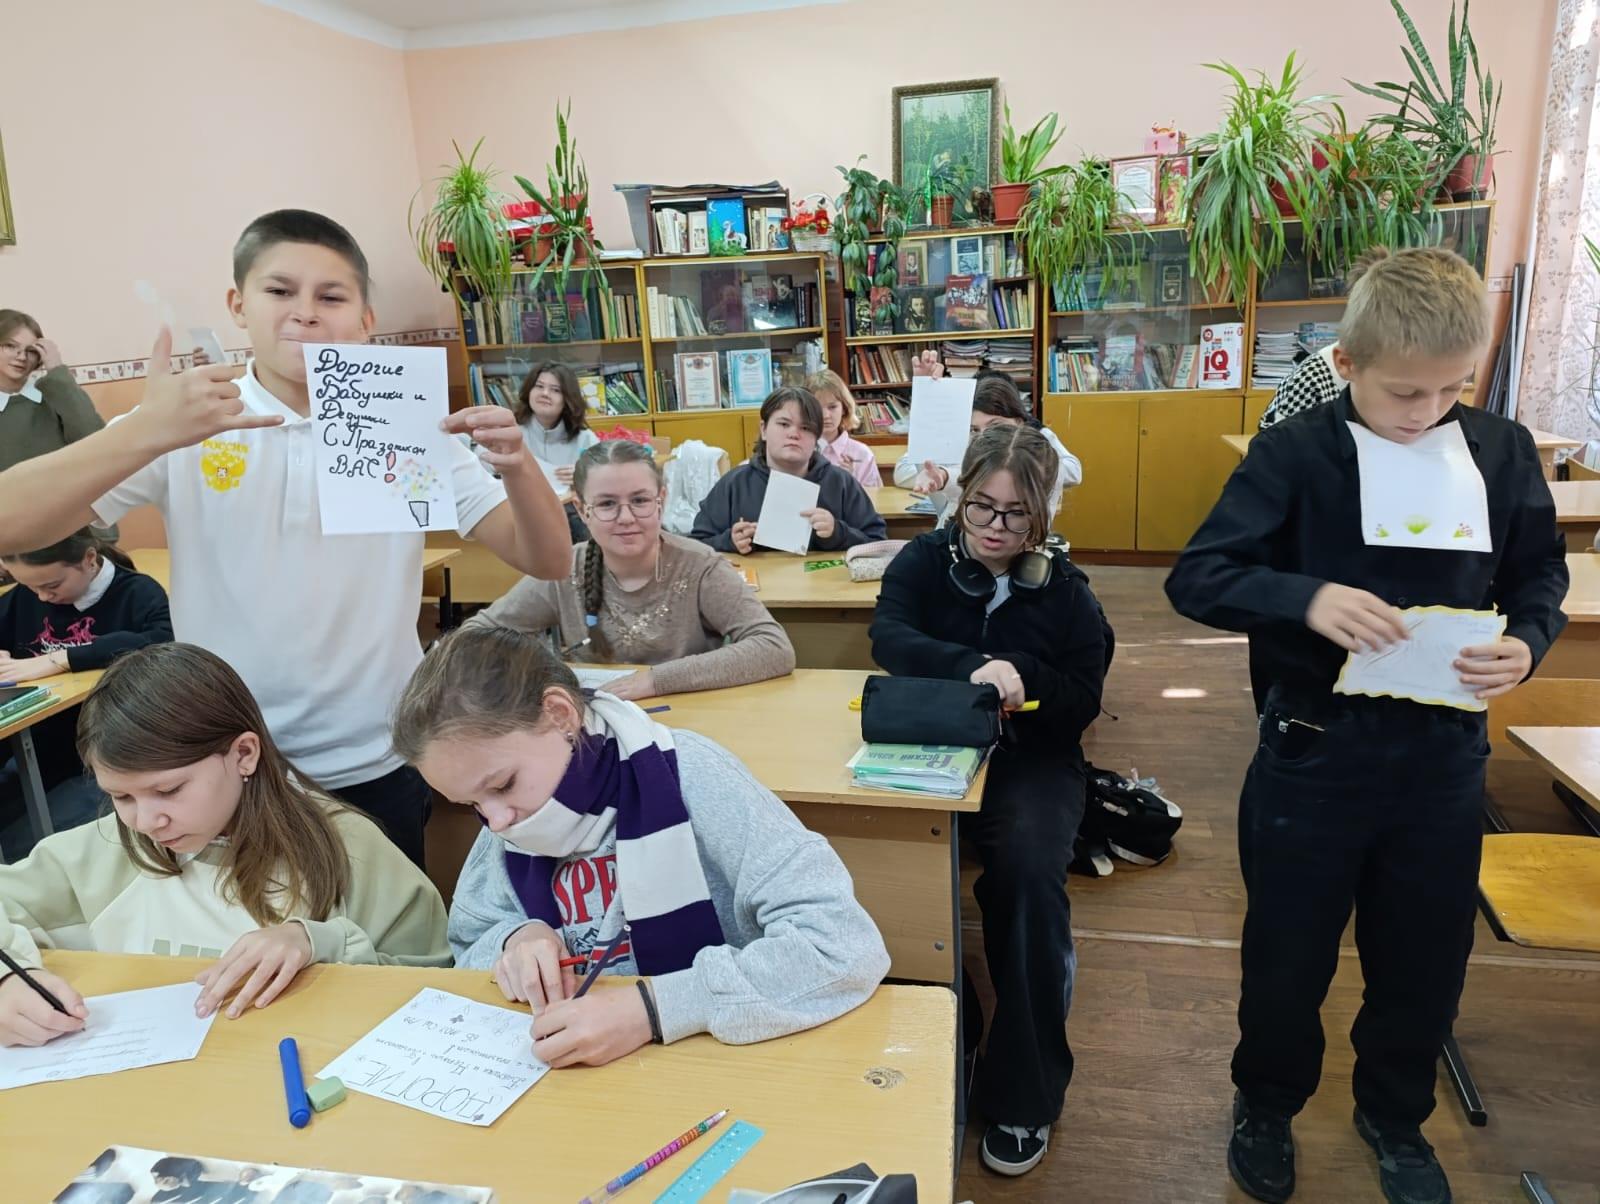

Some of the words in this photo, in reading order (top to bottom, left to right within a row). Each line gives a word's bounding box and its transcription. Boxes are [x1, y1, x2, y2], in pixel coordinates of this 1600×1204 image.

[314, 348, 404, 382] Дорогие
[316, 373, 403, 408] Бабушки
[414, 392, 427, 401] и
[323, 422, 338, 446] С
[346, 1060, 494, 1119] ДОРОГИЕ
